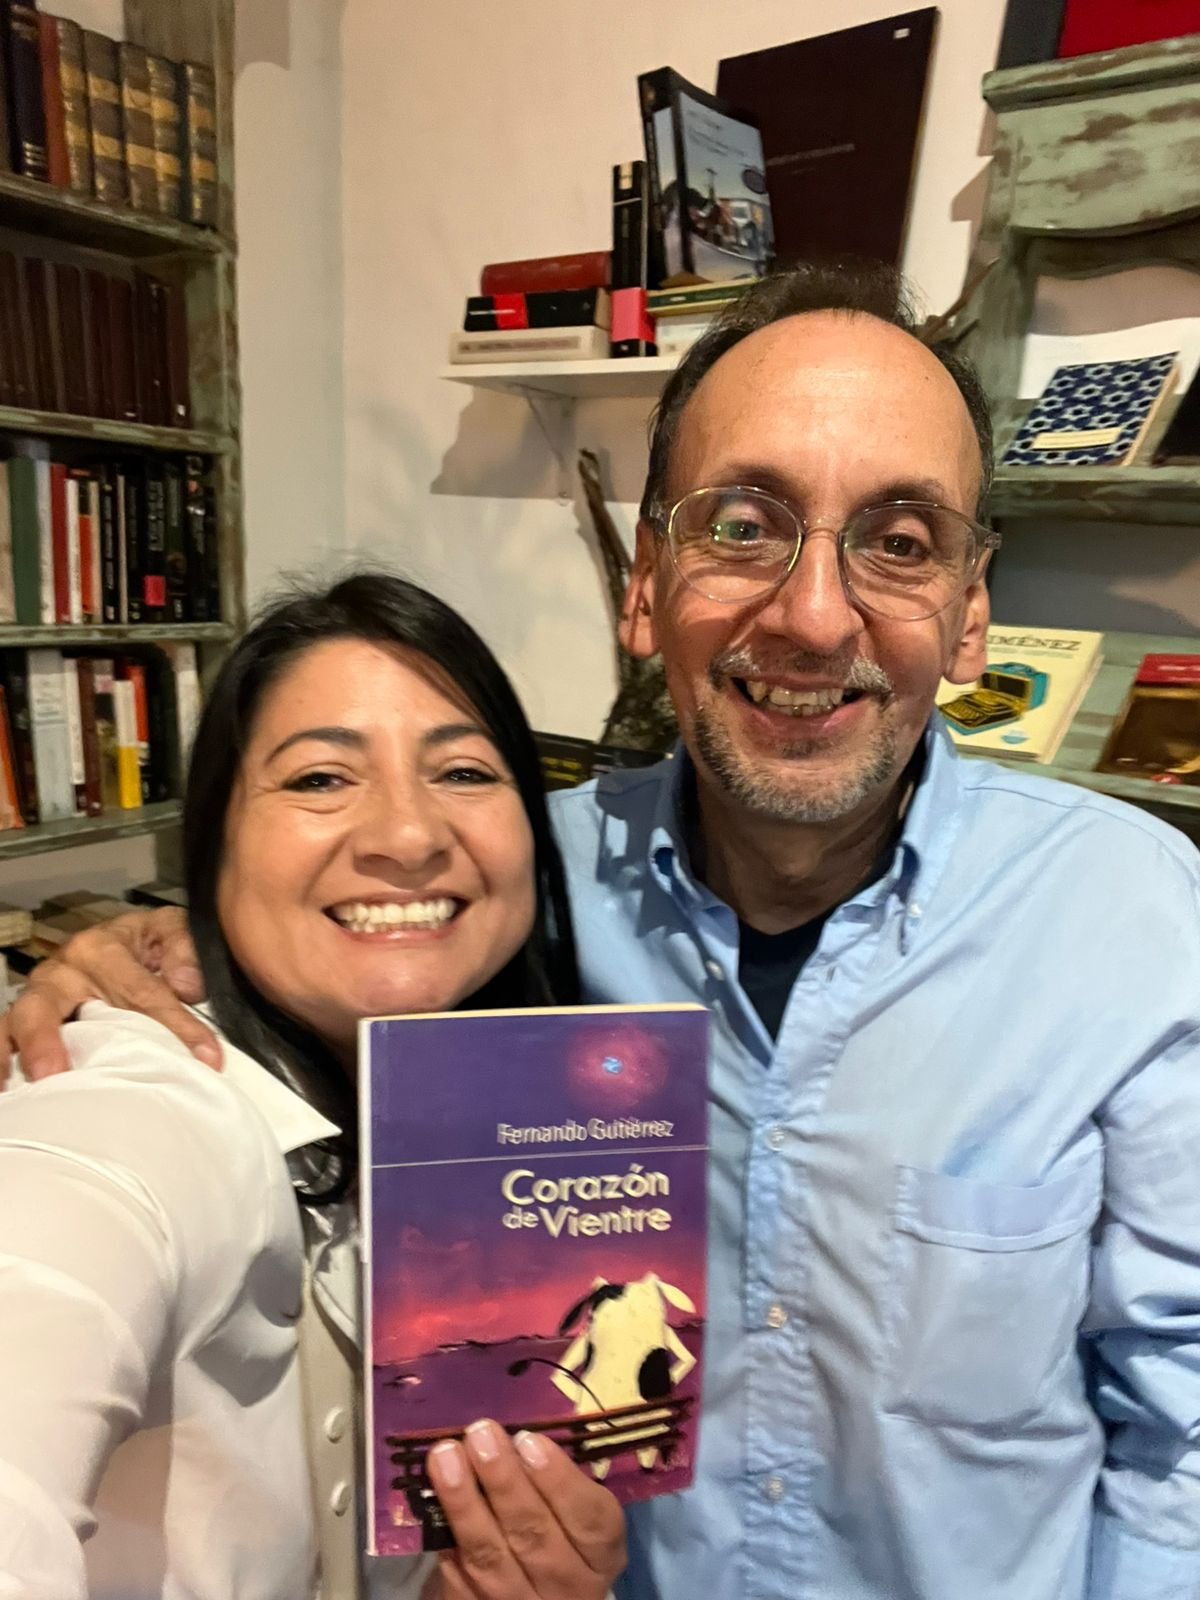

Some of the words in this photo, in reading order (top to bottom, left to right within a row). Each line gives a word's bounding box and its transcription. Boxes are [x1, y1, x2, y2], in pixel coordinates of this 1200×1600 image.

[986, 634, 1081, 651] IMÉNEZ
[497, 1118, 587, 1144] Fernando
[587, 1116, 674, 1141] Gutiérrez
[501, 1162, 670, 1205] Corazón
[502, 1205, 539, 1229] de
[538, 1204, 672, 1238] Vientre
